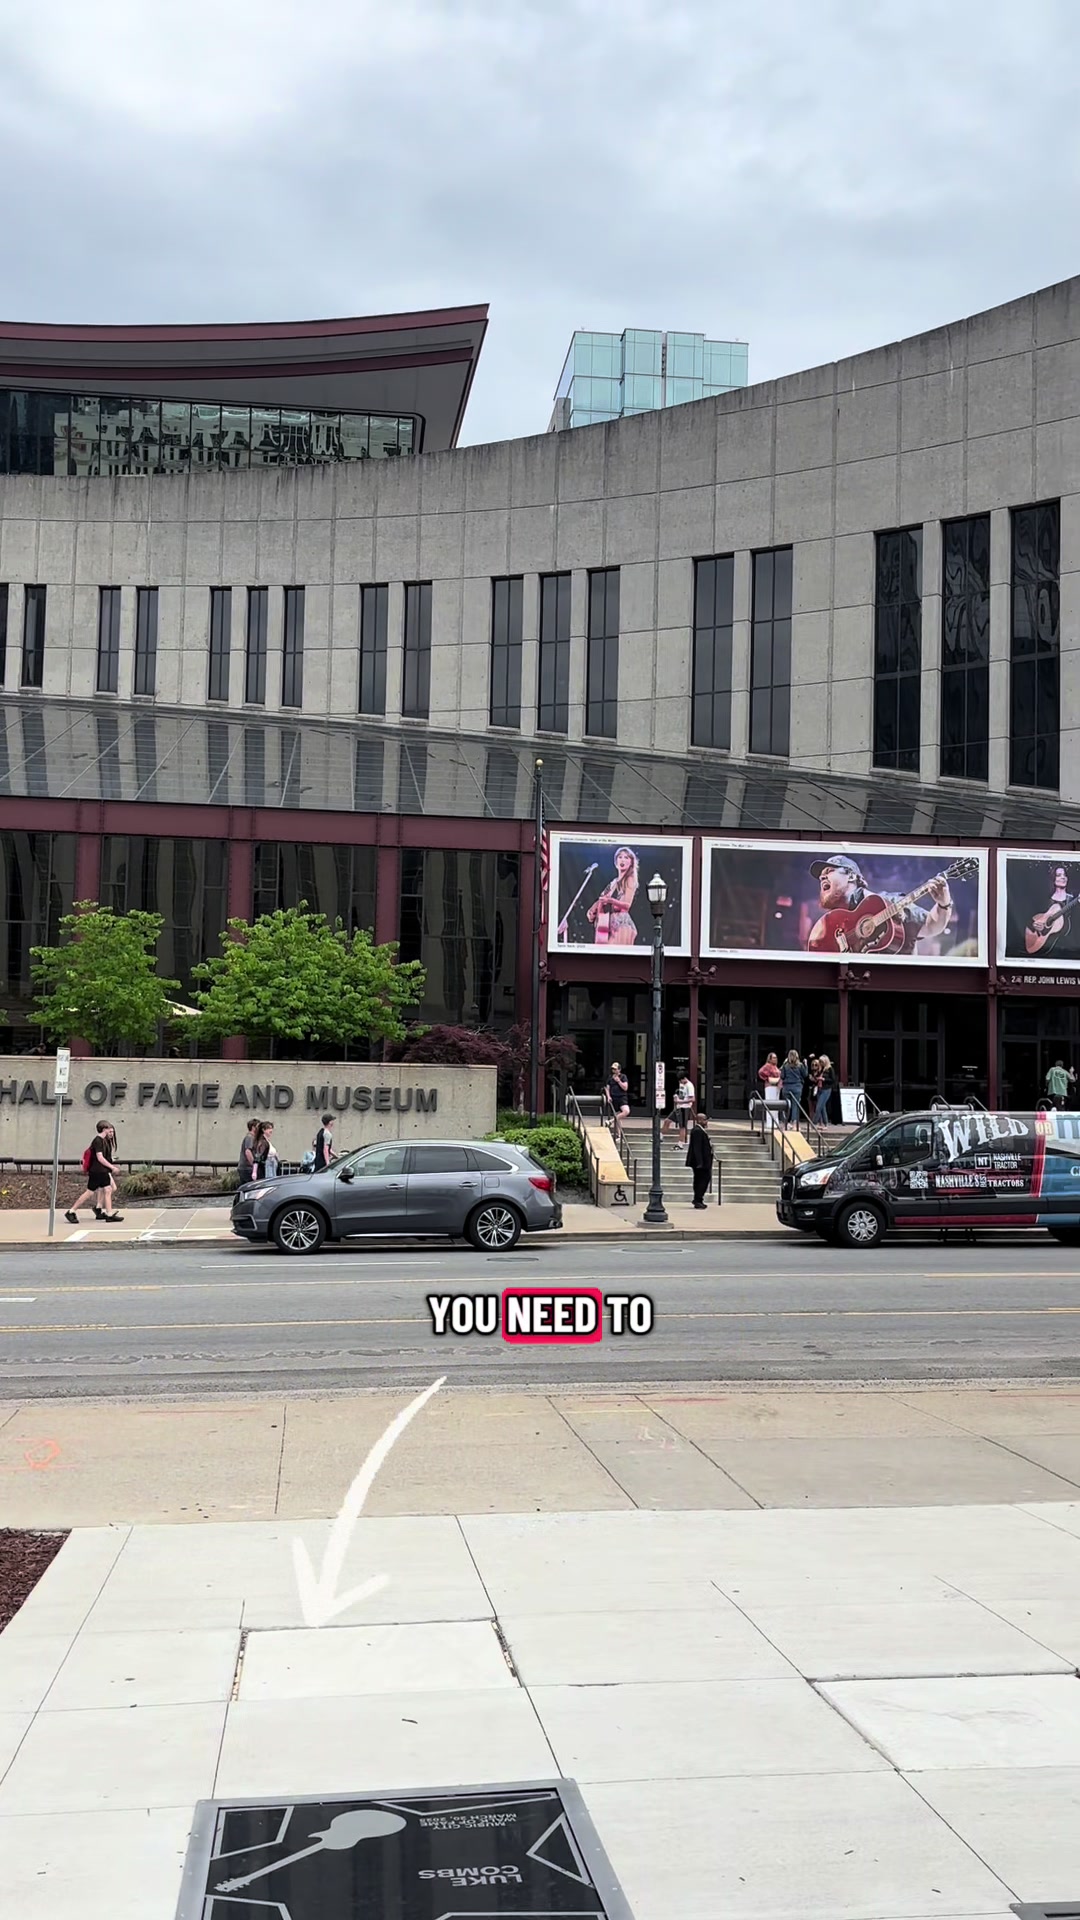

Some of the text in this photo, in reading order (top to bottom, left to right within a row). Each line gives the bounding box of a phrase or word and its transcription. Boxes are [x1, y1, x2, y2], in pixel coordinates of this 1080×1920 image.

[1024, 975, 1037, 984] REP.
[1038, 976, 1055, 985] JOHN
[1056, 976, 1076, 985] LEWIS
[0, 1080, 438, 1112] HAL OF FAME AND MUSEUM
[938, 1114, 1029, 1163] WILD
[1035, 1120, 1053, 1135] OR
[993, 1153, 1021, 1161] NASHVILLE
[994, 1161, 1018, 1169] TRACTOR
[935, 1174, 980, 1188] NASHVILLE'S
[988, 1179, 1024, 1188] TRACTORS
[432, 1821, 506, 1831] MUSIC CITY
[418, 1865, 519, 1879] COMBS
[450, 1874, 522, 1887] LUKE
